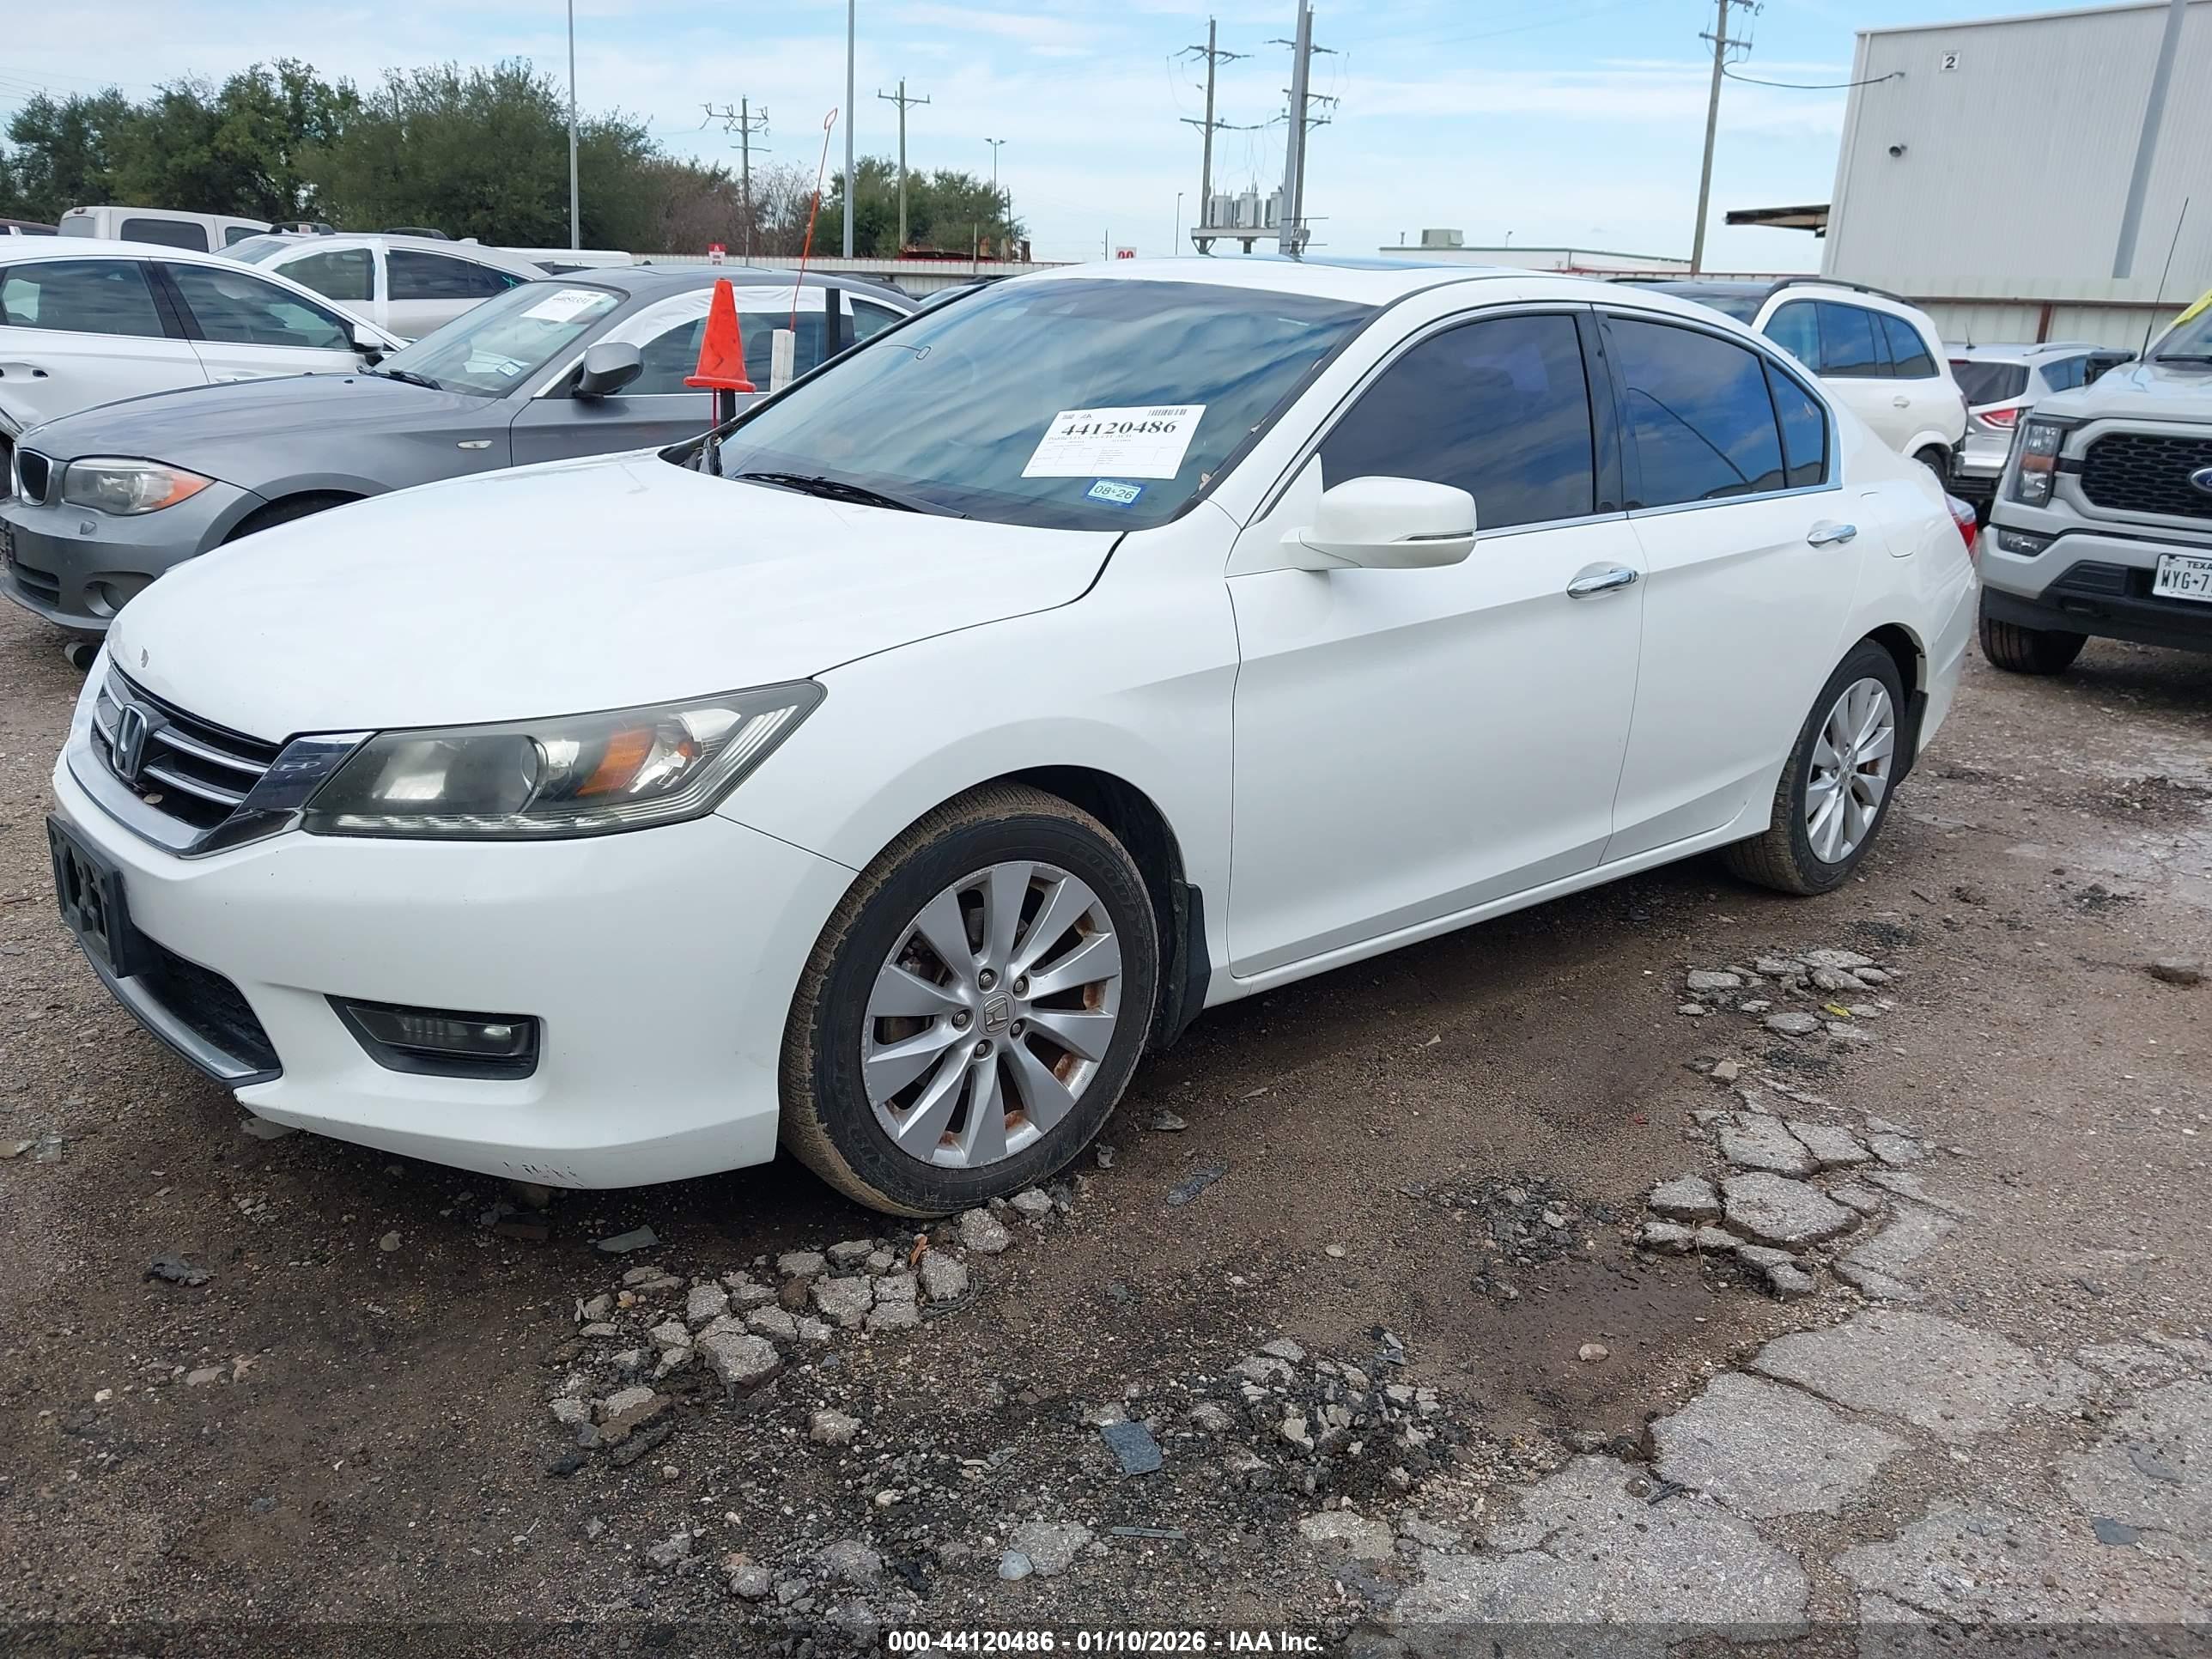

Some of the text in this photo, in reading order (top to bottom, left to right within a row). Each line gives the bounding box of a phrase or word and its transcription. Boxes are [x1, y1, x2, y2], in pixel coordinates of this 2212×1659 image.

[1945, 56, 1955, 69] 2
[1061, 420, 1179, 435] 44120486
[2160, 569, 2212, 592] WYG-7
